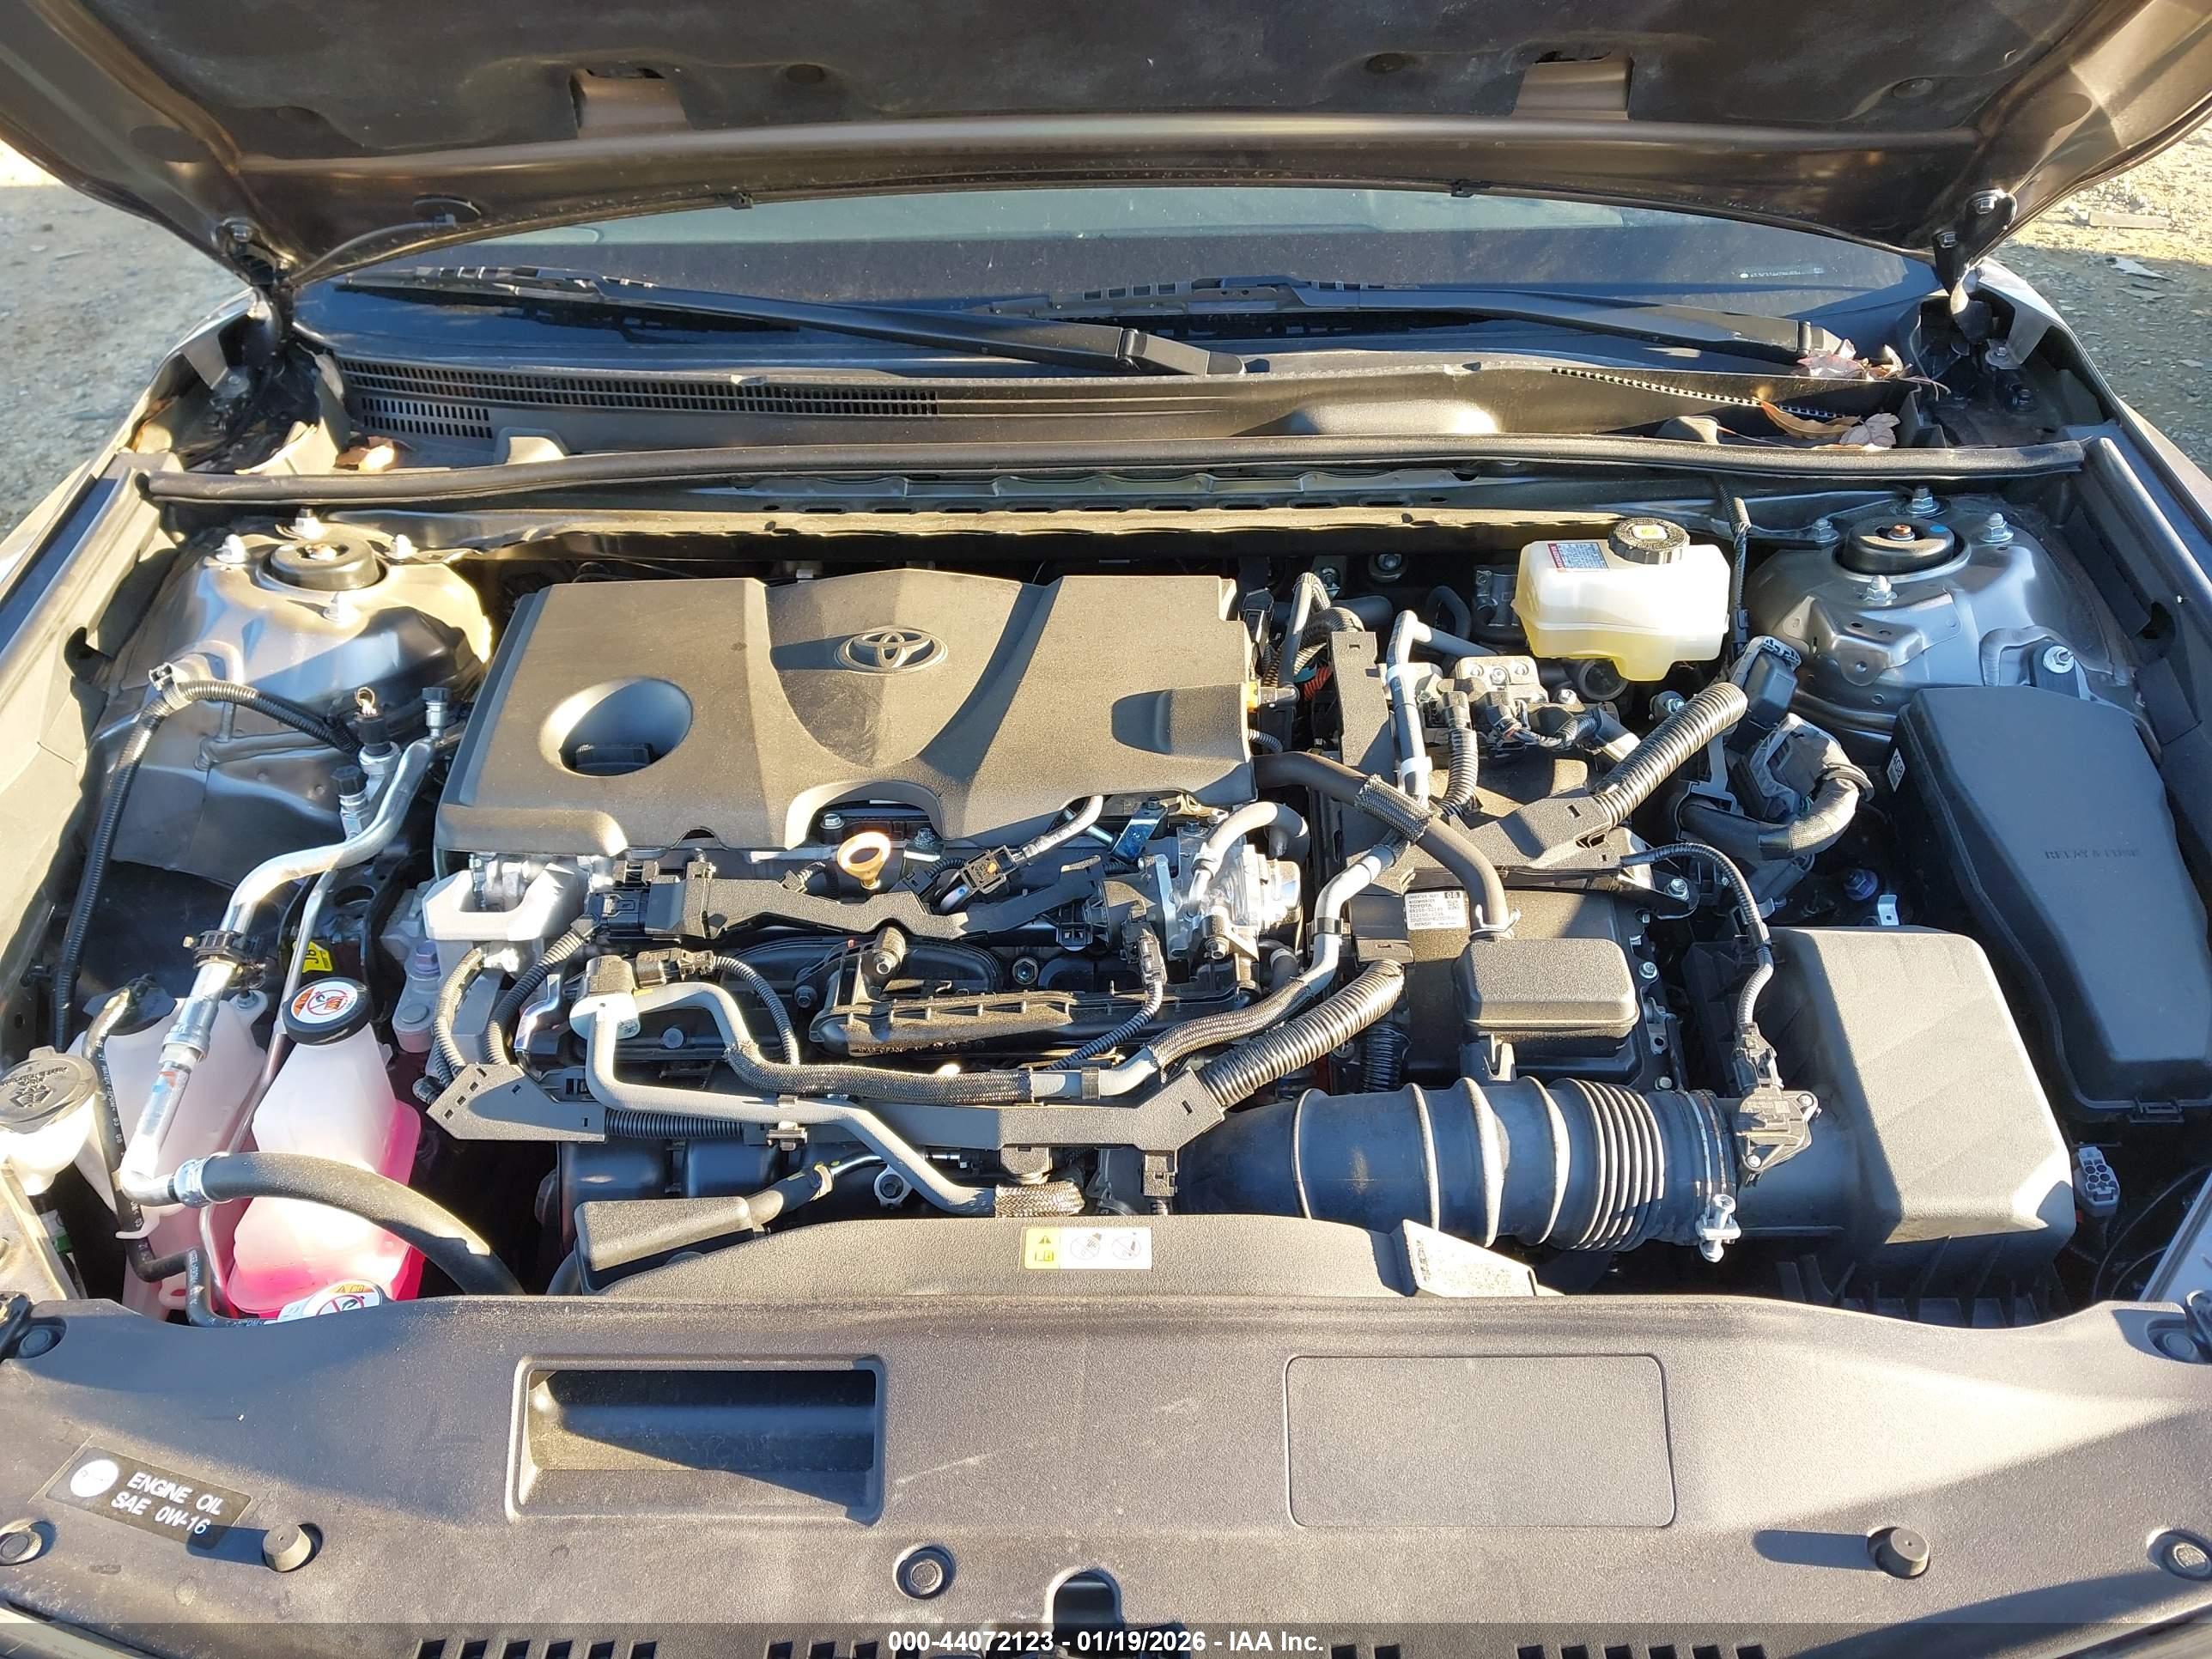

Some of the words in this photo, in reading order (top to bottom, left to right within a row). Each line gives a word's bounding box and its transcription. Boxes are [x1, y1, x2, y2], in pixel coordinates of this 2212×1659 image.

[111, 1491, 152, 1516] SAE
[155, 1505, 211, 1534] 0W-16
[126, 1471, 193, 1504] ENGINE
[196, 1493, 224, 1516] OIL
